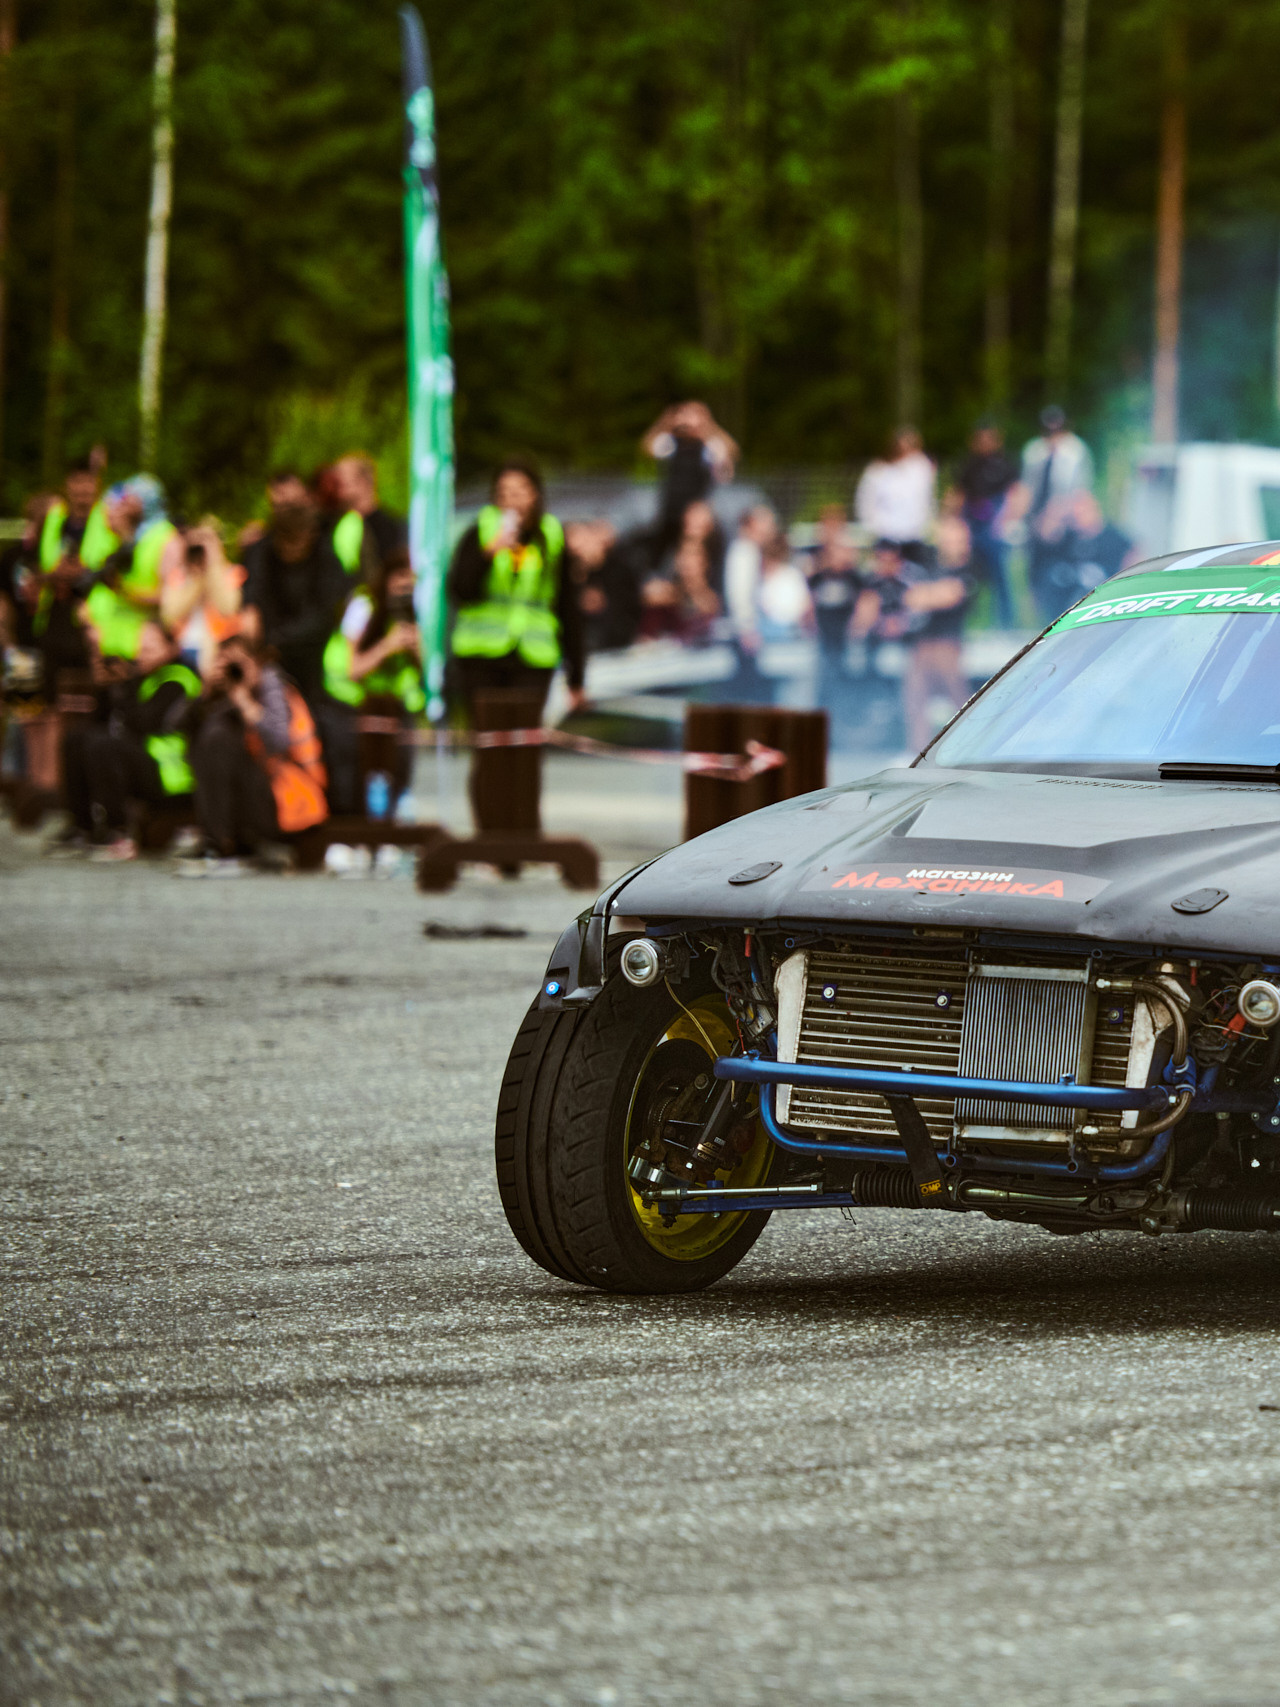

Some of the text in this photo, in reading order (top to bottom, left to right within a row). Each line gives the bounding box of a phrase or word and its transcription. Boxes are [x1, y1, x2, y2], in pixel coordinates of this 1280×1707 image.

[1075, 594, 1199, 623] DRIFT
[831, 871, 1065, 898] МеханикА
[905, 868, 1015, 882] магазин
[920, 1182, 941, 1195] OMP
